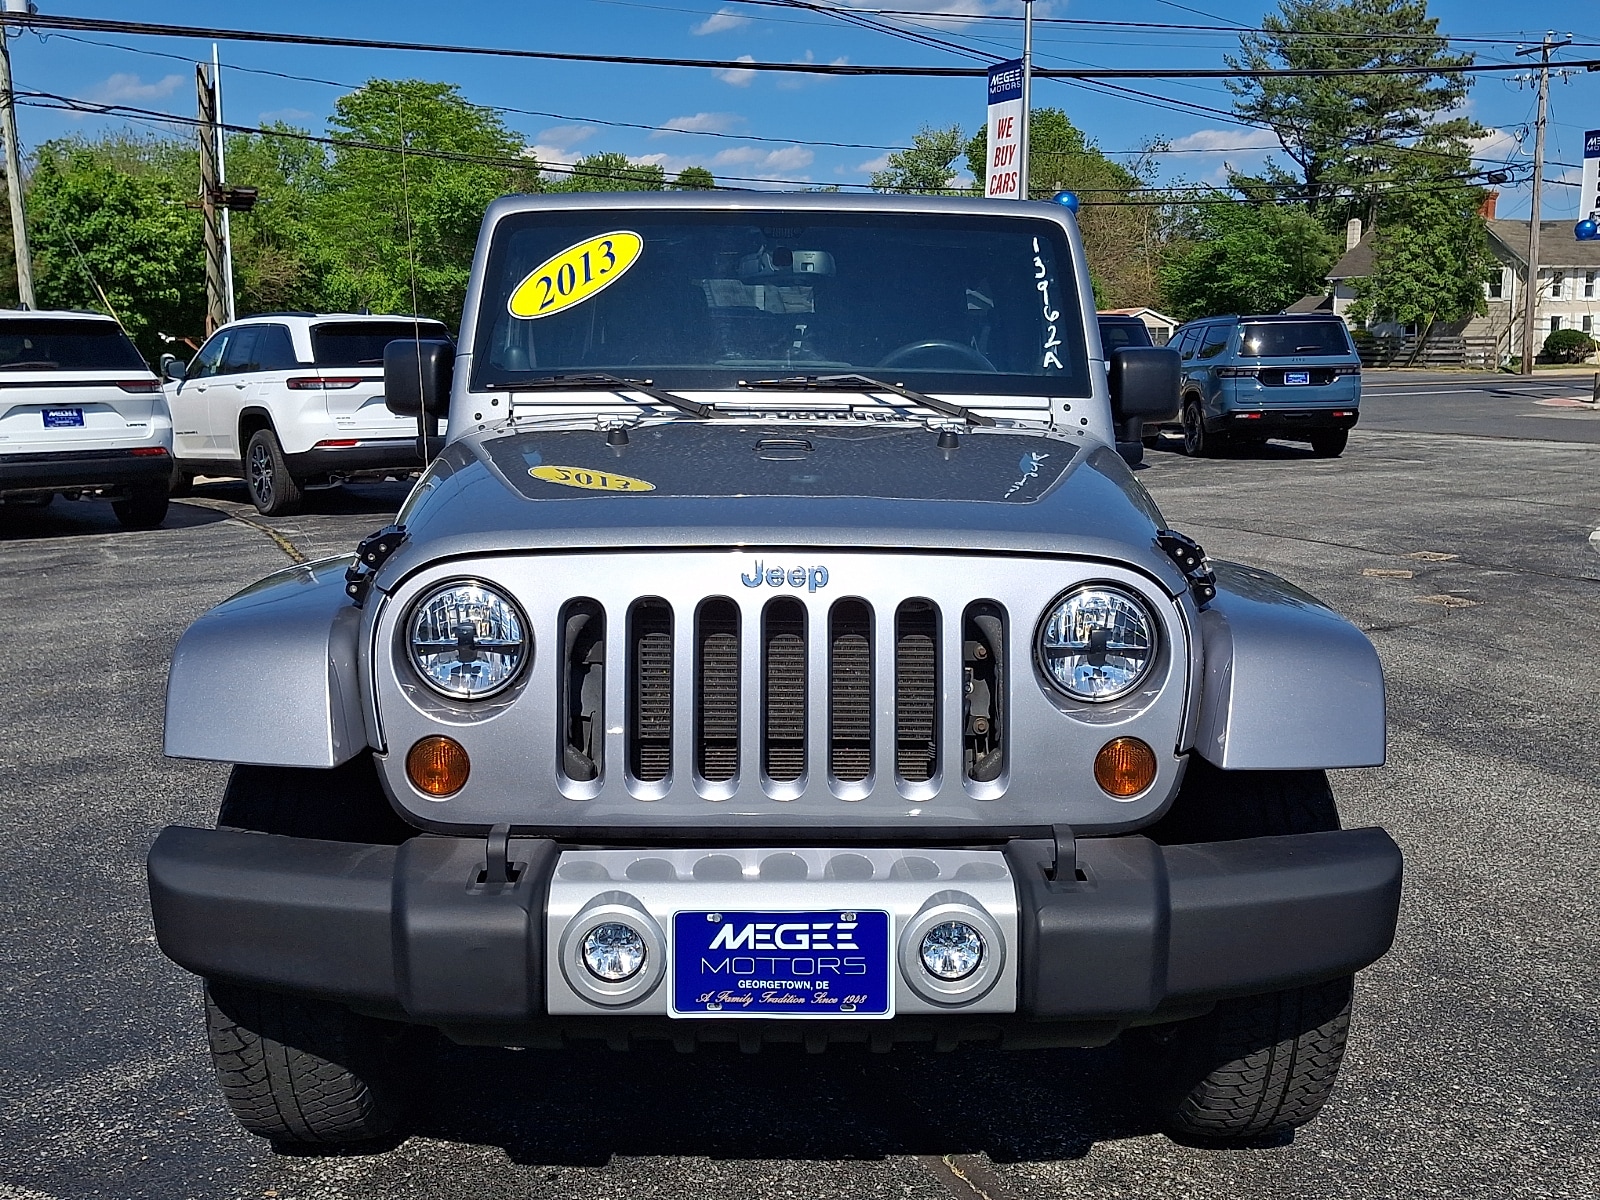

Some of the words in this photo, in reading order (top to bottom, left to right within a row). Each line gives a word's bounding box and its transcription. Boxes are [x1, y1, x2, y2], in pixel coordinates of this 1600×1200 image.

[989, 80, 1022, 95] MOTORS
[990, 68, 1021, 87] MEGEE
[997, 116, 1014, 140] WE
[993, 144, 1017, 168] BUY
[989, 171, 1018, 196] CARS
[535, 240, 616, 311] 2013
[1032, 236, 1064, 369] 13962A
[741, 559, 829, 593] Jeep
[708, 922, 860, 950] MEGEE
[701, 956, 867, 975] MOTORS
[737, 980, 814, 991] GEORGETOWN,
[815, 980, 830, 990] DE
[695, 990, 716, 1003] A
[714, 990, 754, 1008] Family
[758, 990, 806, 1004] Tradition
[810, 991, 839, 1004] Since
